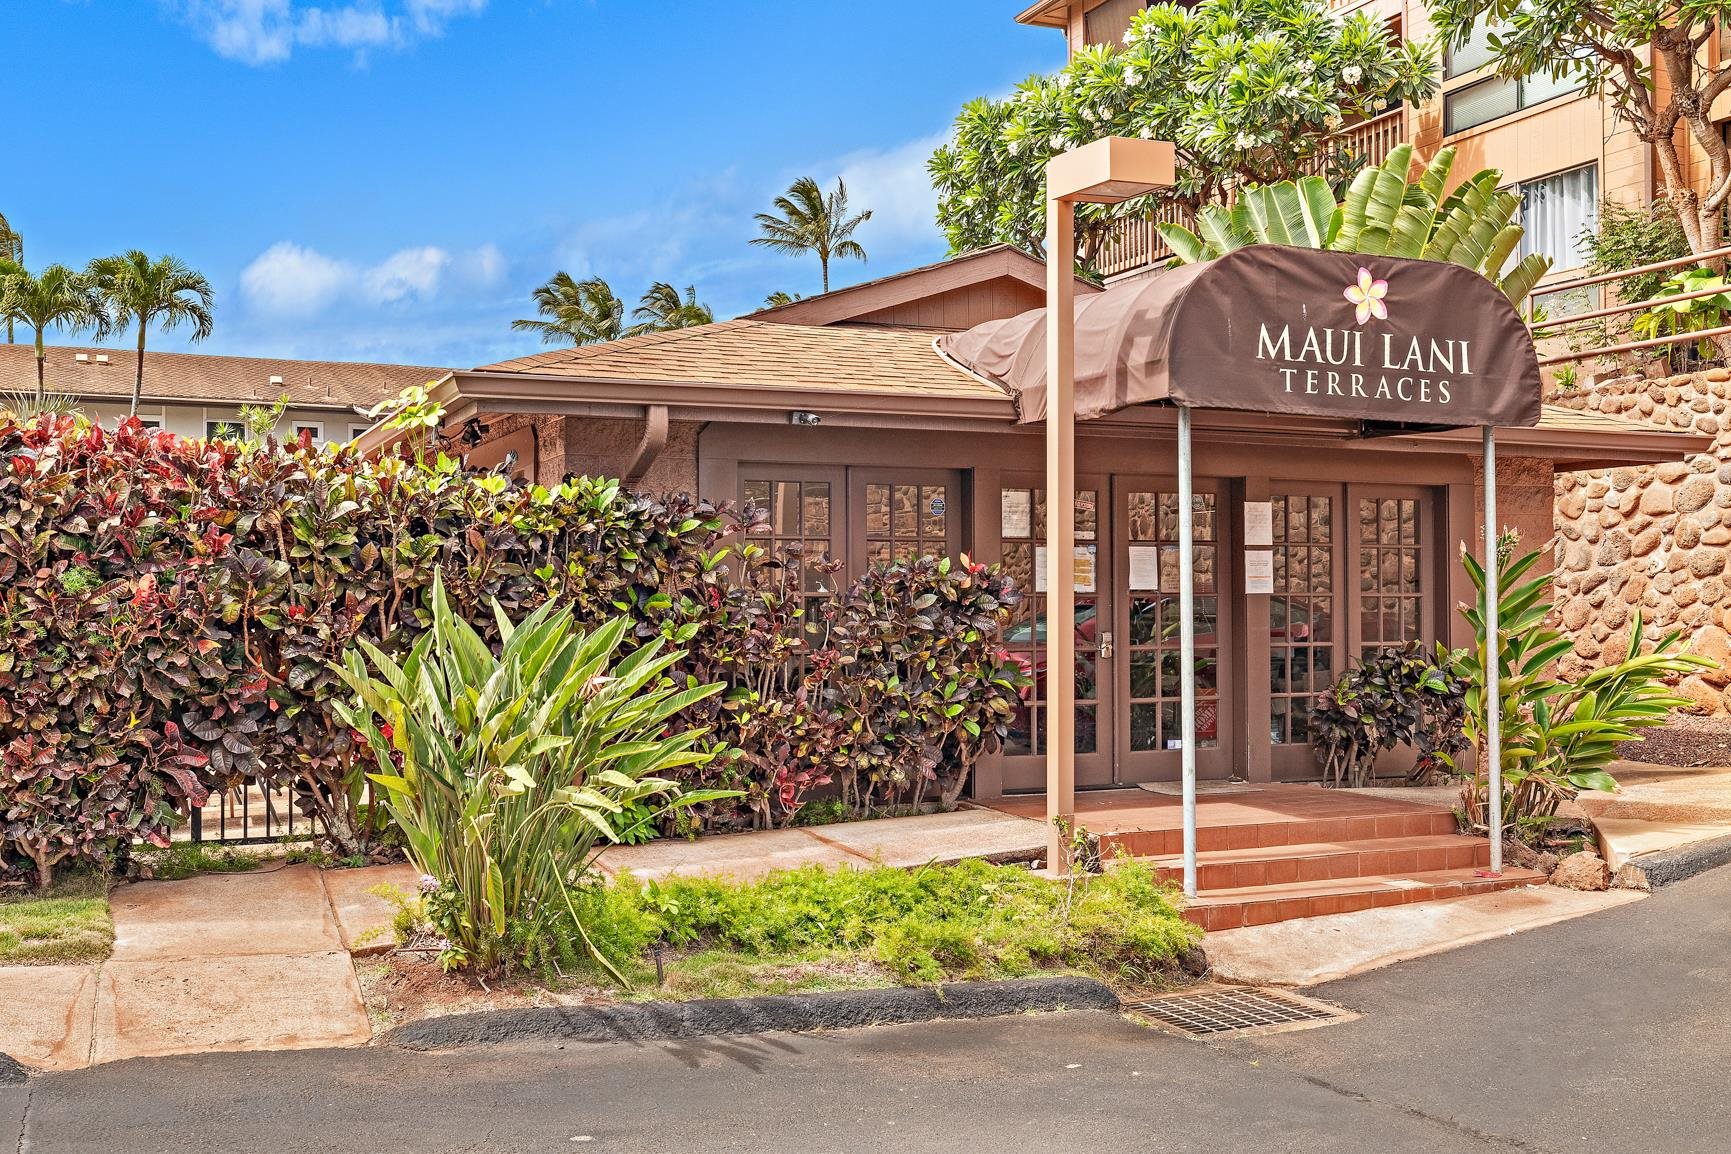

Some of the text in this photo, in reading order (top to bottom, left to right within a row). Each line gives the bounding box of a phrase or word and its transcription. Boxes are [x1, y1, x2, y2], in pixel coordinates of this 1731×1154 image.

[1255, 322, 1474, 375] MAUI LANI
[1279, 368, 1452, 404] TERRACES
